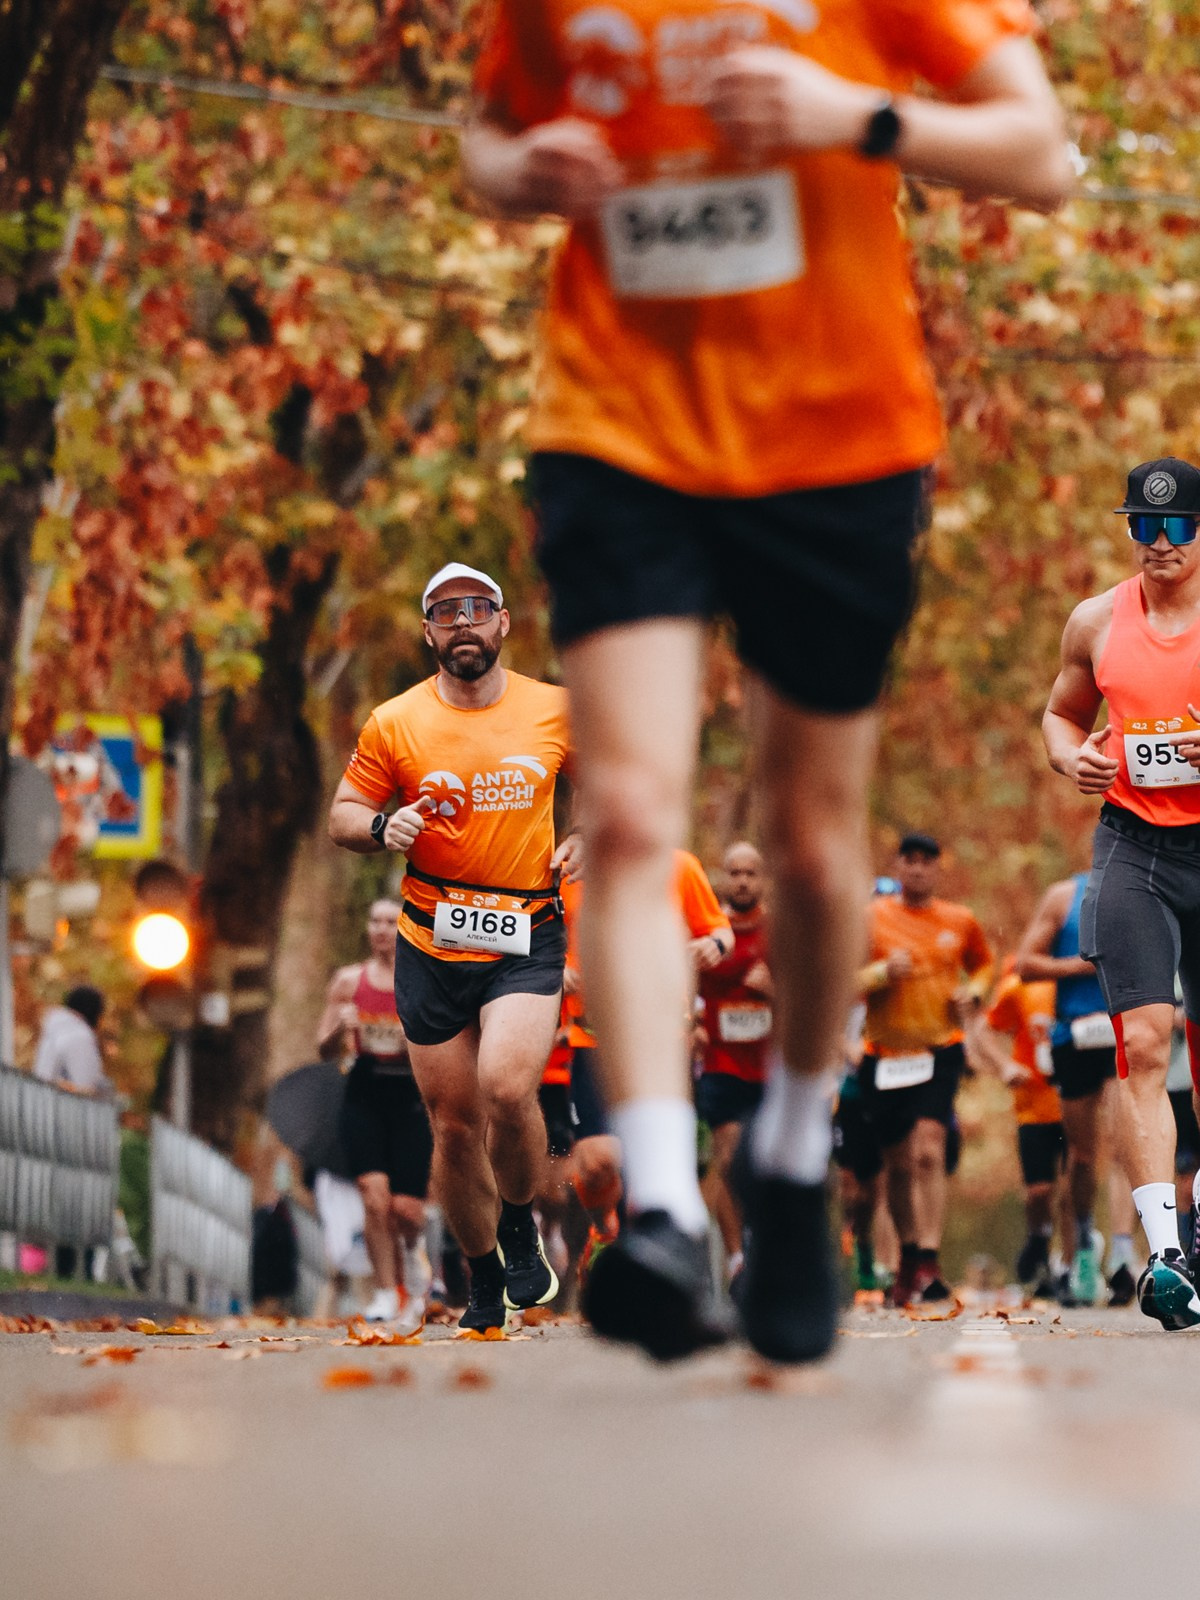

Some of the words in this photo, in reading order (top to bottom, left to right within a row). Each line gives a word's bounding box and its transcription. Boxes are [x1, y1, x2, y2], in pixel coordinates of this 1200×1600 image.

[1136, 743, 1189, 766] 955
[471, 769, 527, 788] ANTA
[471, 784, 535, 803] SOCHI
[473, 800, 533, 812] MARATHON
[450, 907, 517, 937] 9168
[466, 933, 498, 942] АЛЕКСЕЙ
